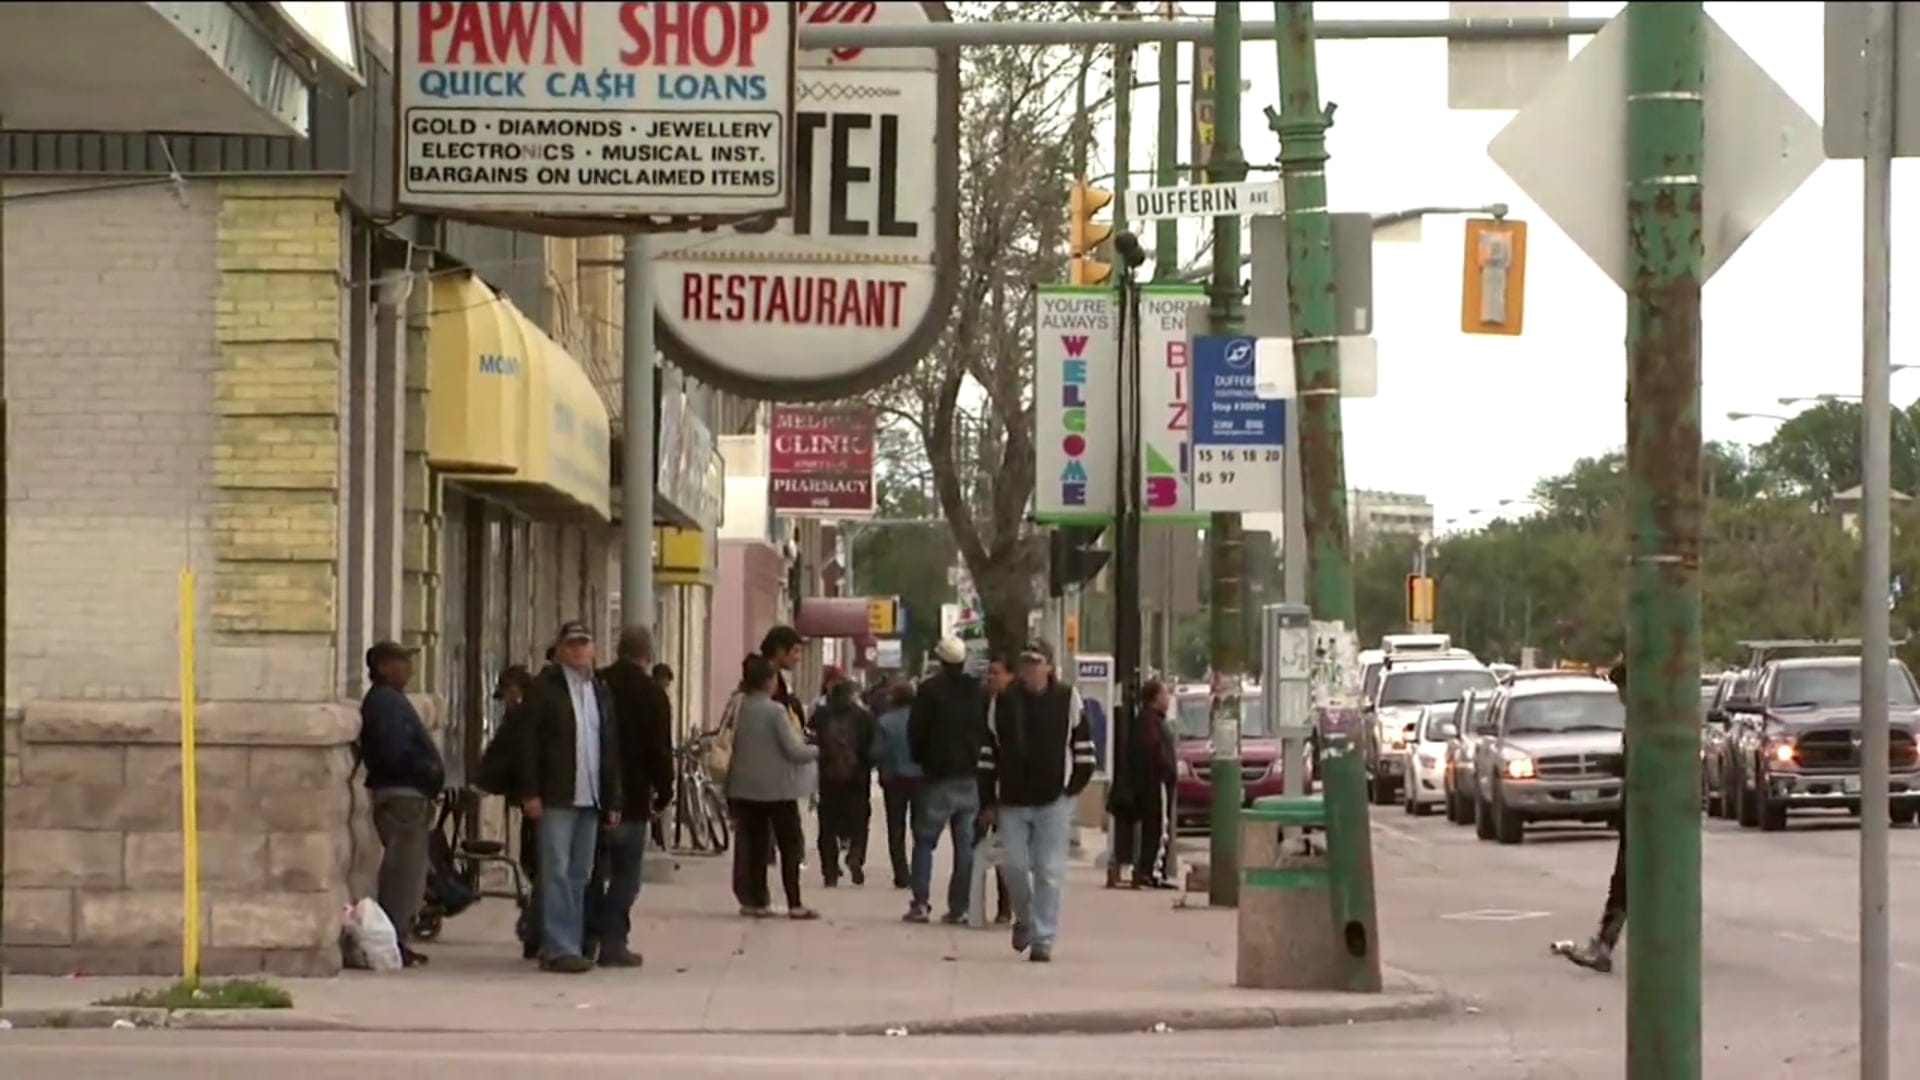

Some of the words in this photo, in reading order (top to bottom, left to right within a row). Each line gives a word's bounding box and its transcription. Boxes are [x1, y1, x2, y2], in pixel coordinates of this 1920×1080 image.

[418, 2, 583, 65] PAWN
[619, 2, 769, 67] SHOP
[420, 70, 526, 98] QUICK
[546, 67, 635, 101] CA$H
[658, 74, 768, 100] LOANS
[412, 118, 476, 135] GOLD
[499, 120, 622, 137] DIAMONDS
[646, 121, 772, 138] JEWELLERY
[422, 142, 575, 160] ELECTRONICS
[602, 145, 703, 162] MUSICAL
[711, 146, 765, 162] INST.
[409, 166, 528, 183] BARGAINS
[537, 168, 570, 184] ON
[579, 169, 705, 185] UNCLAIMED
[711, 170, 775, 186] ITEMS
[1136, 188, 1237, 216] DUFFERIN
[1250, 191, 1269, 203] AVE
[683, 272, 907, 328] RESTAURANT
[1043, 299, 1106, 313] YOU'RE
[1150, 301, 1195, 314] NOR
[1042, 315, 1109, 329] ALWAYS
[1161, 316, 1185, 330] EN
[775, 434, 868, 455] CLINIC
[1199, 449, 1213, 461] 15
[1221, 449, 1235, 461] 16
[1264, 449, 1280, 461] 20
[774, 478, 867, 494] PHARMACY
[1198, 471, 1213, 484] 45
[1219, 471, 1235, 484] 97
